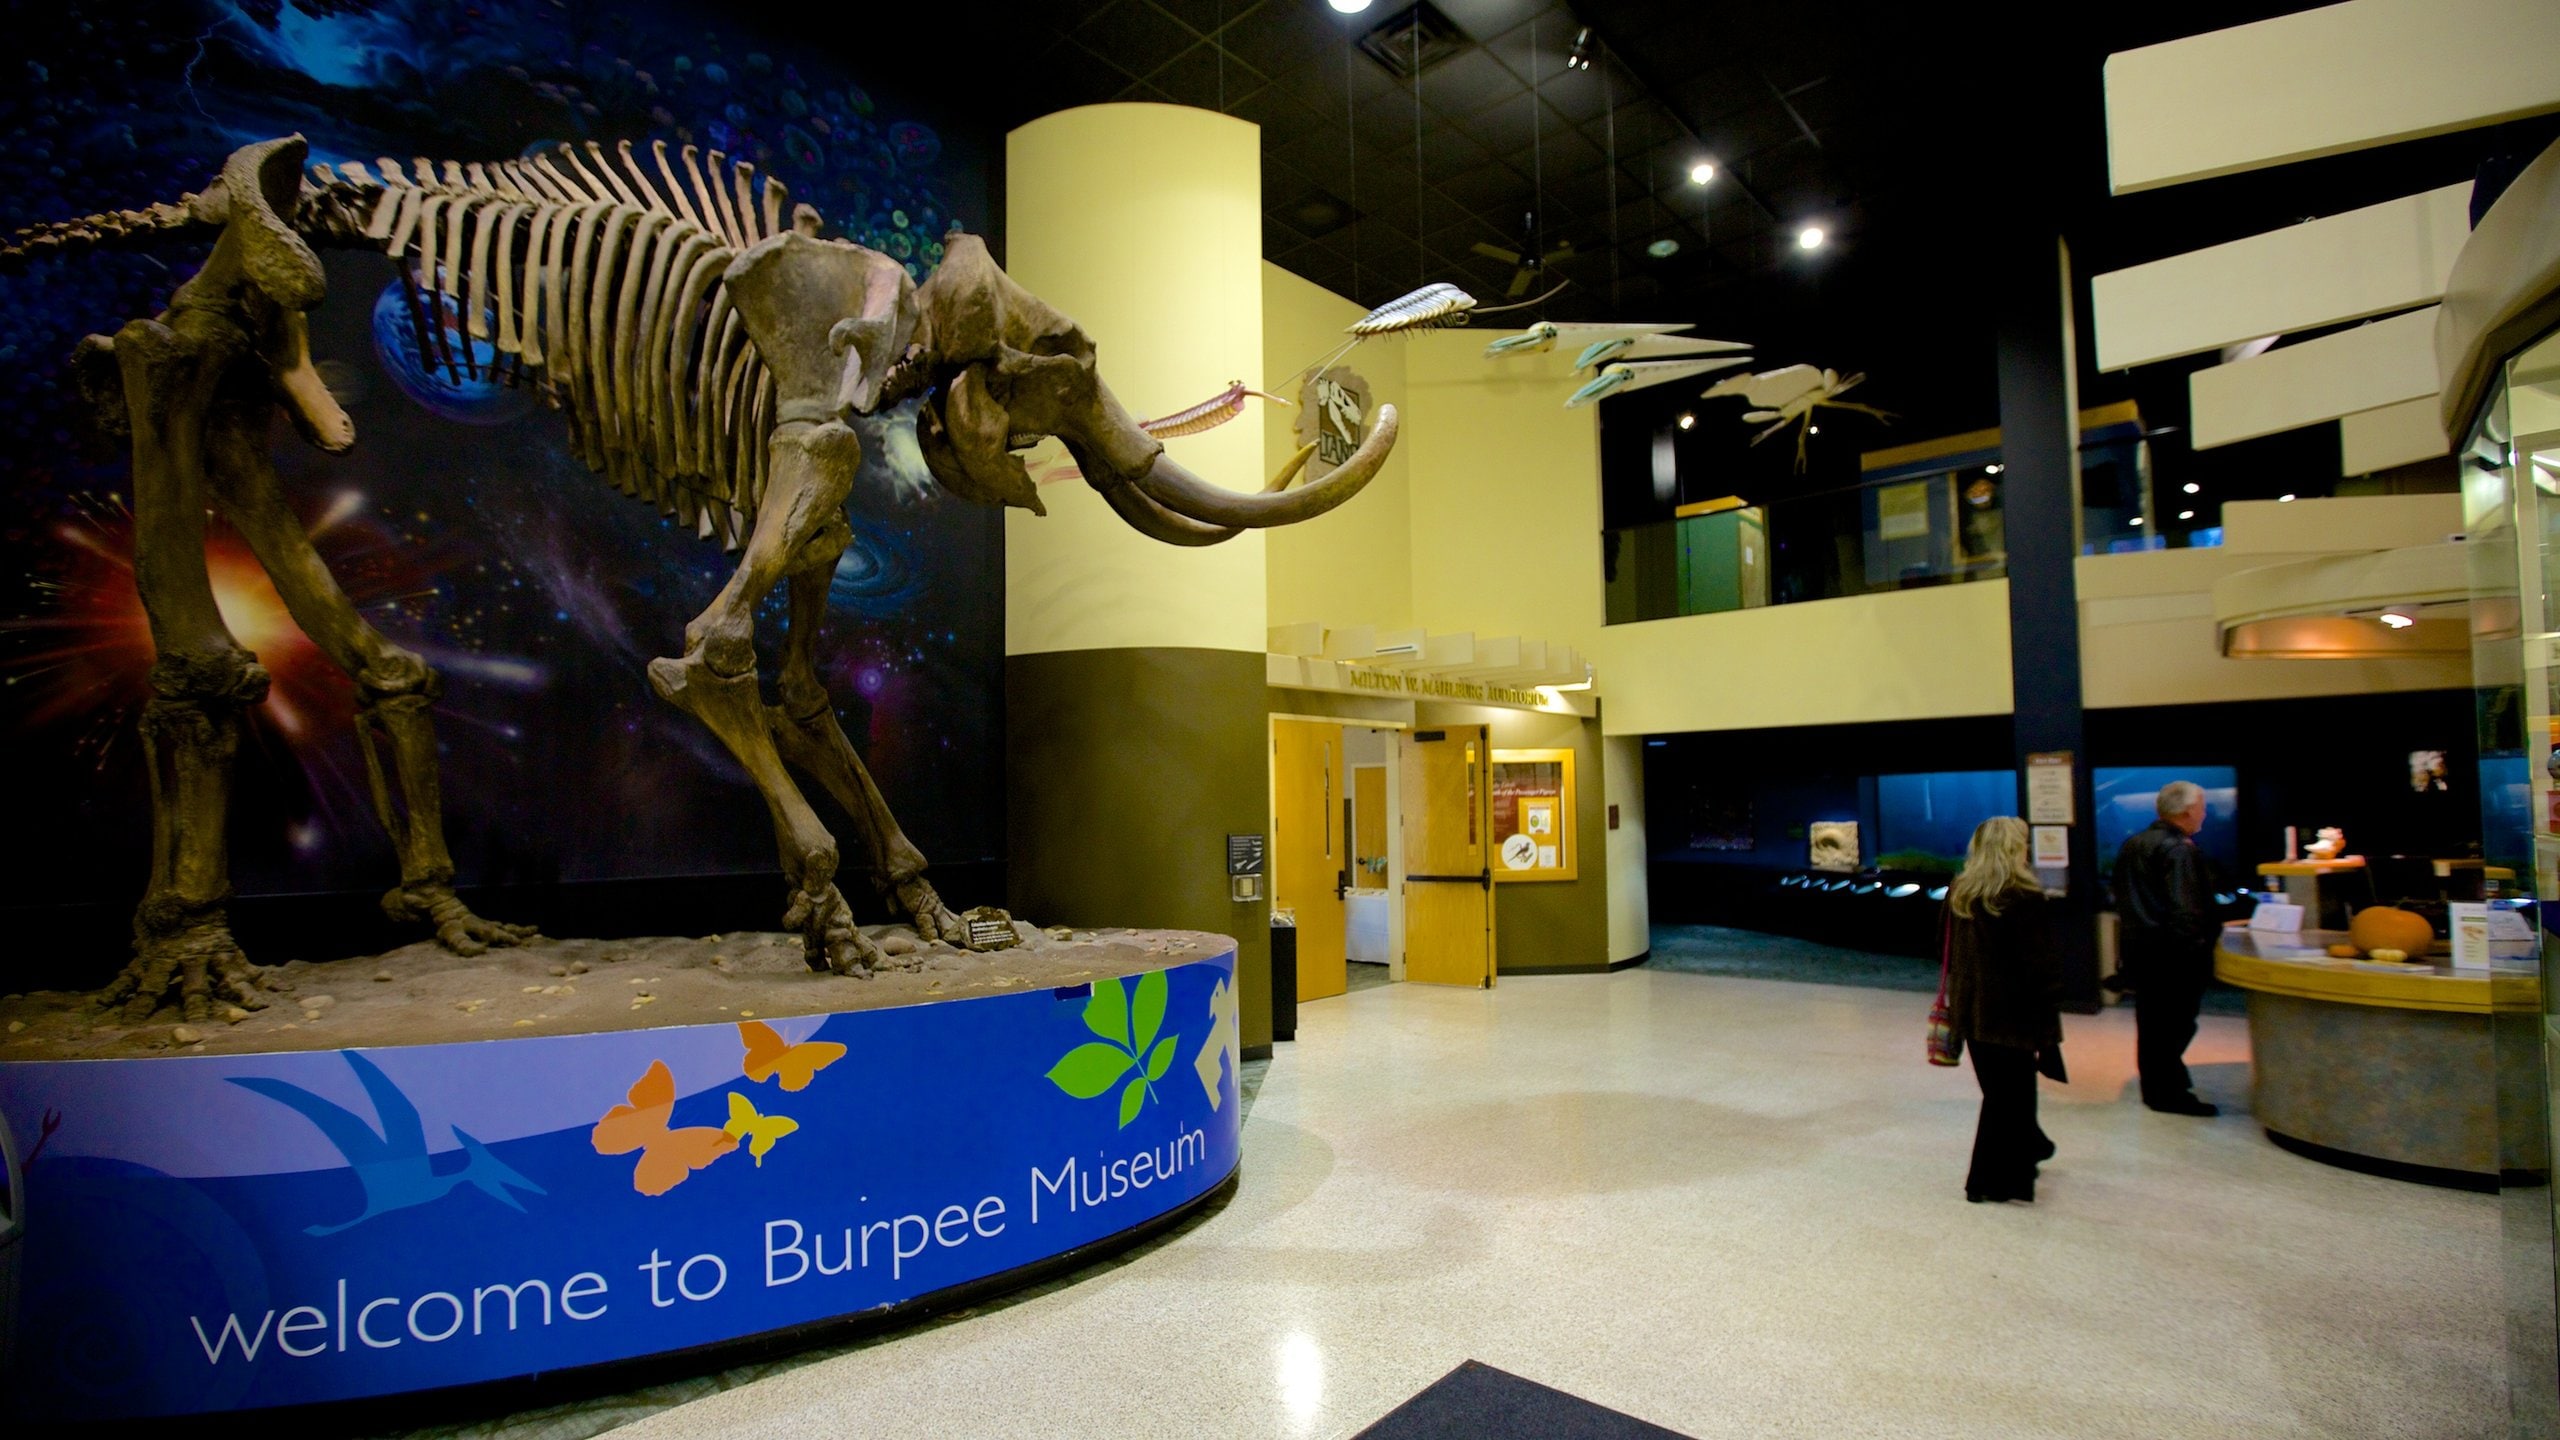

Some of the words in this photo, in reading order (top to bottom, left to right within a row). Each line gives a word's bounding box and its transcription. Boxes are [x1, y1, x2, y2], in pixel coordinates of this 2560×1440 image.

[1350, 670, 1401, 691] MILTON
[1405, 676, 1419, 692] W.
[1422, 678, 1483, 701] MAHLBURG
[1487, 685, 1549, 706] AUDITORIUM
[190, 1272, 608, 1365] welcome
[638, 1249, 727, 1307] to
[765, 1196, 1007, 1287] Burpee
[1031, 1129, 1206, 1224] Museum
